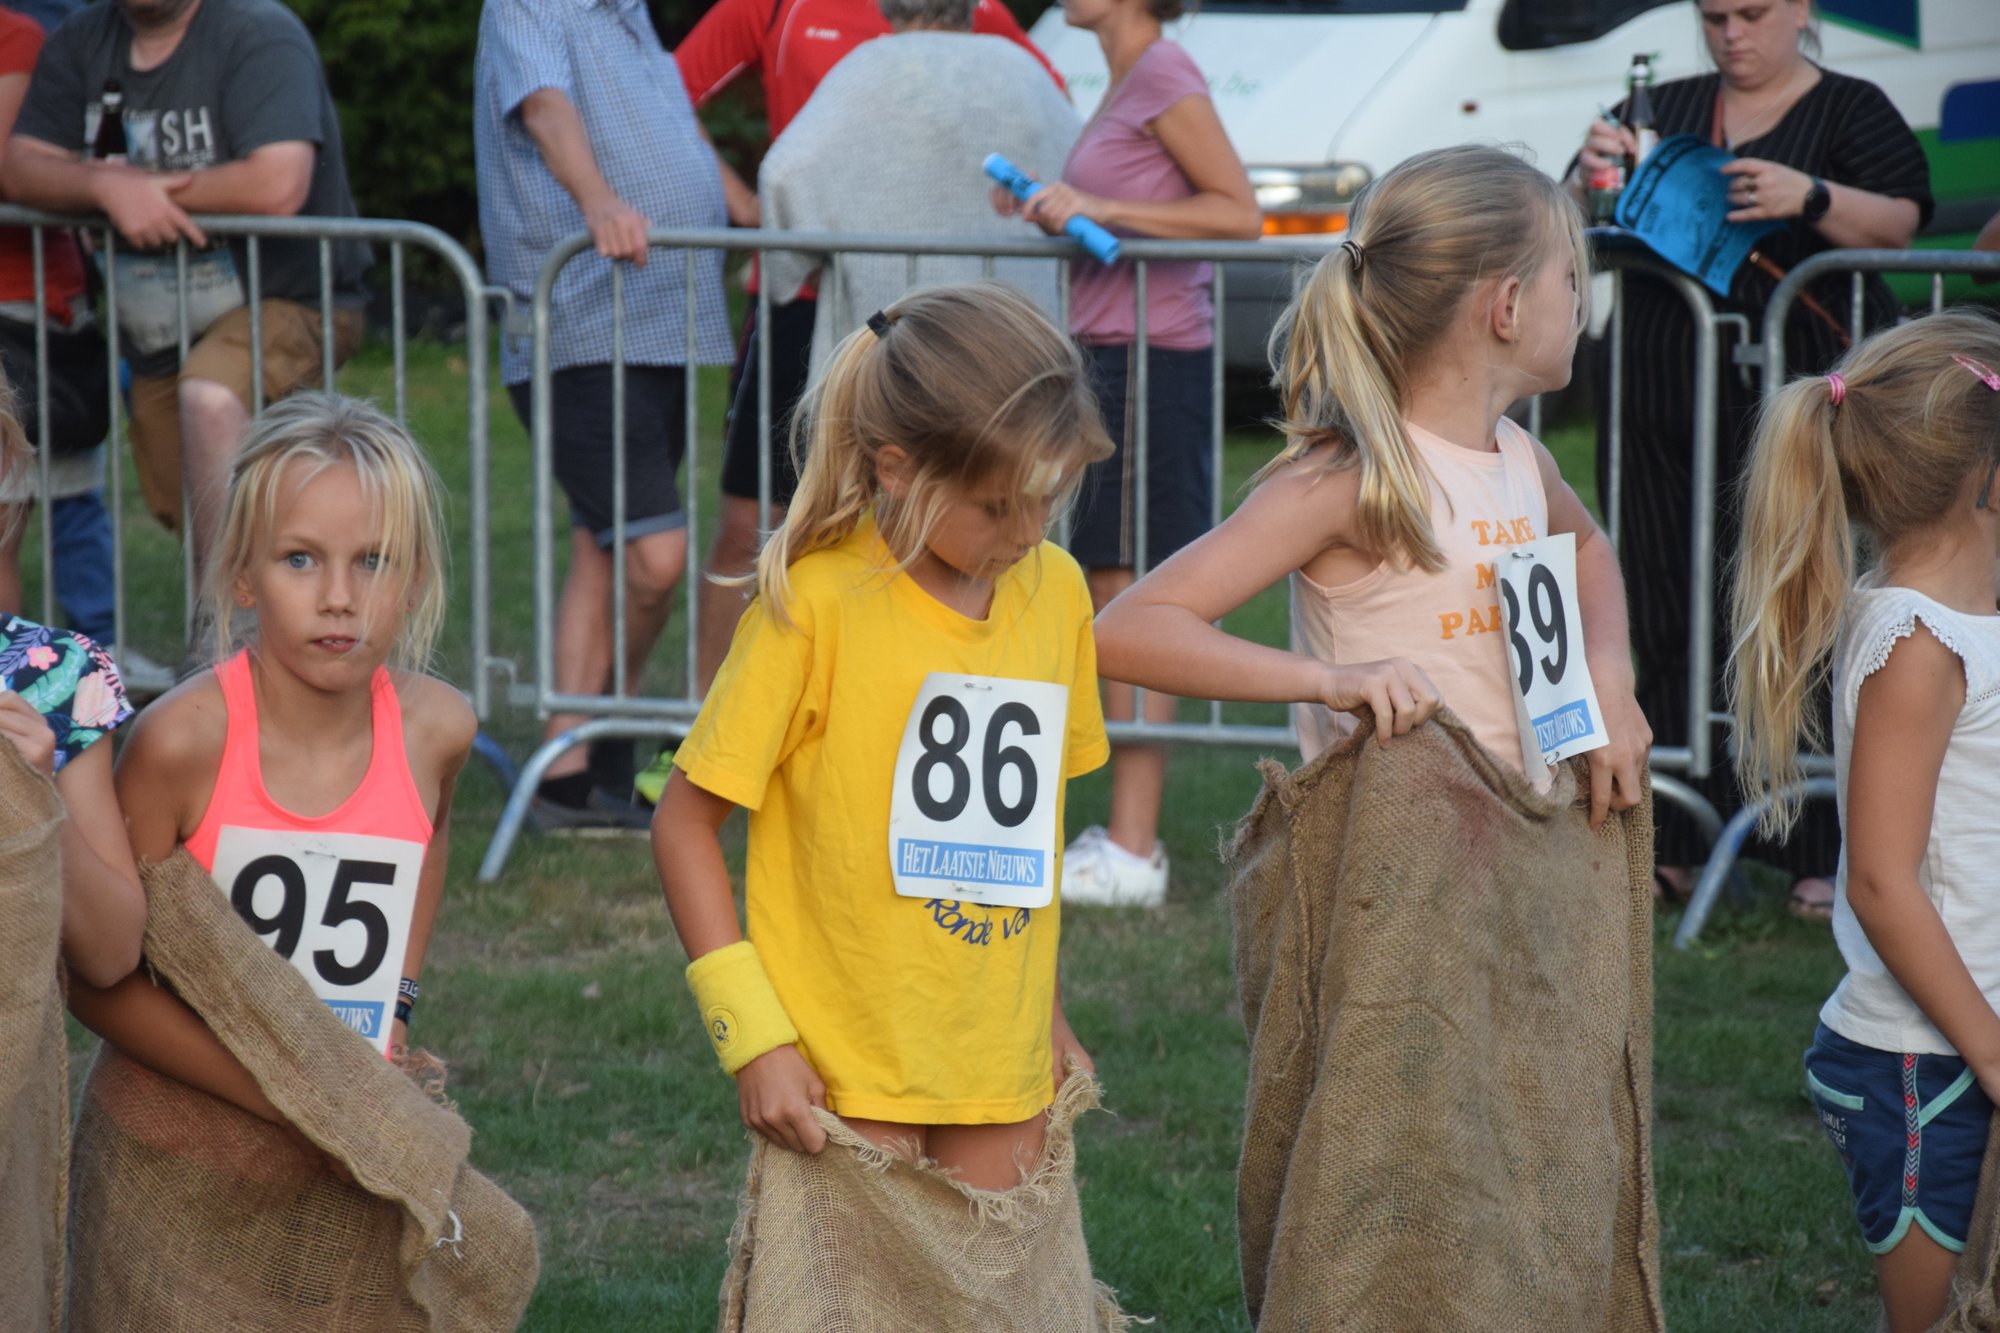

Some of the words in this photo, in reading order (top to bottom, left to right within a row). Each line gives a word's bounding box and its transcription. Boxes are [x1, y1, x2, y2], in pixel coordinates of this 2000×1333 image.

[1471, 516, 1536, 545] TAKE
[1475, 562, 1497, 590] M
[911, 694, 1041, 828] 86
[902, 842, 931, 874] HET
[929, 845, 987, 879] LAATSTE
[986, 849, 1036, 884] NIEUWS
[230, 854, 397, 987] 95
[924, 898, 993, 946] Ronde
